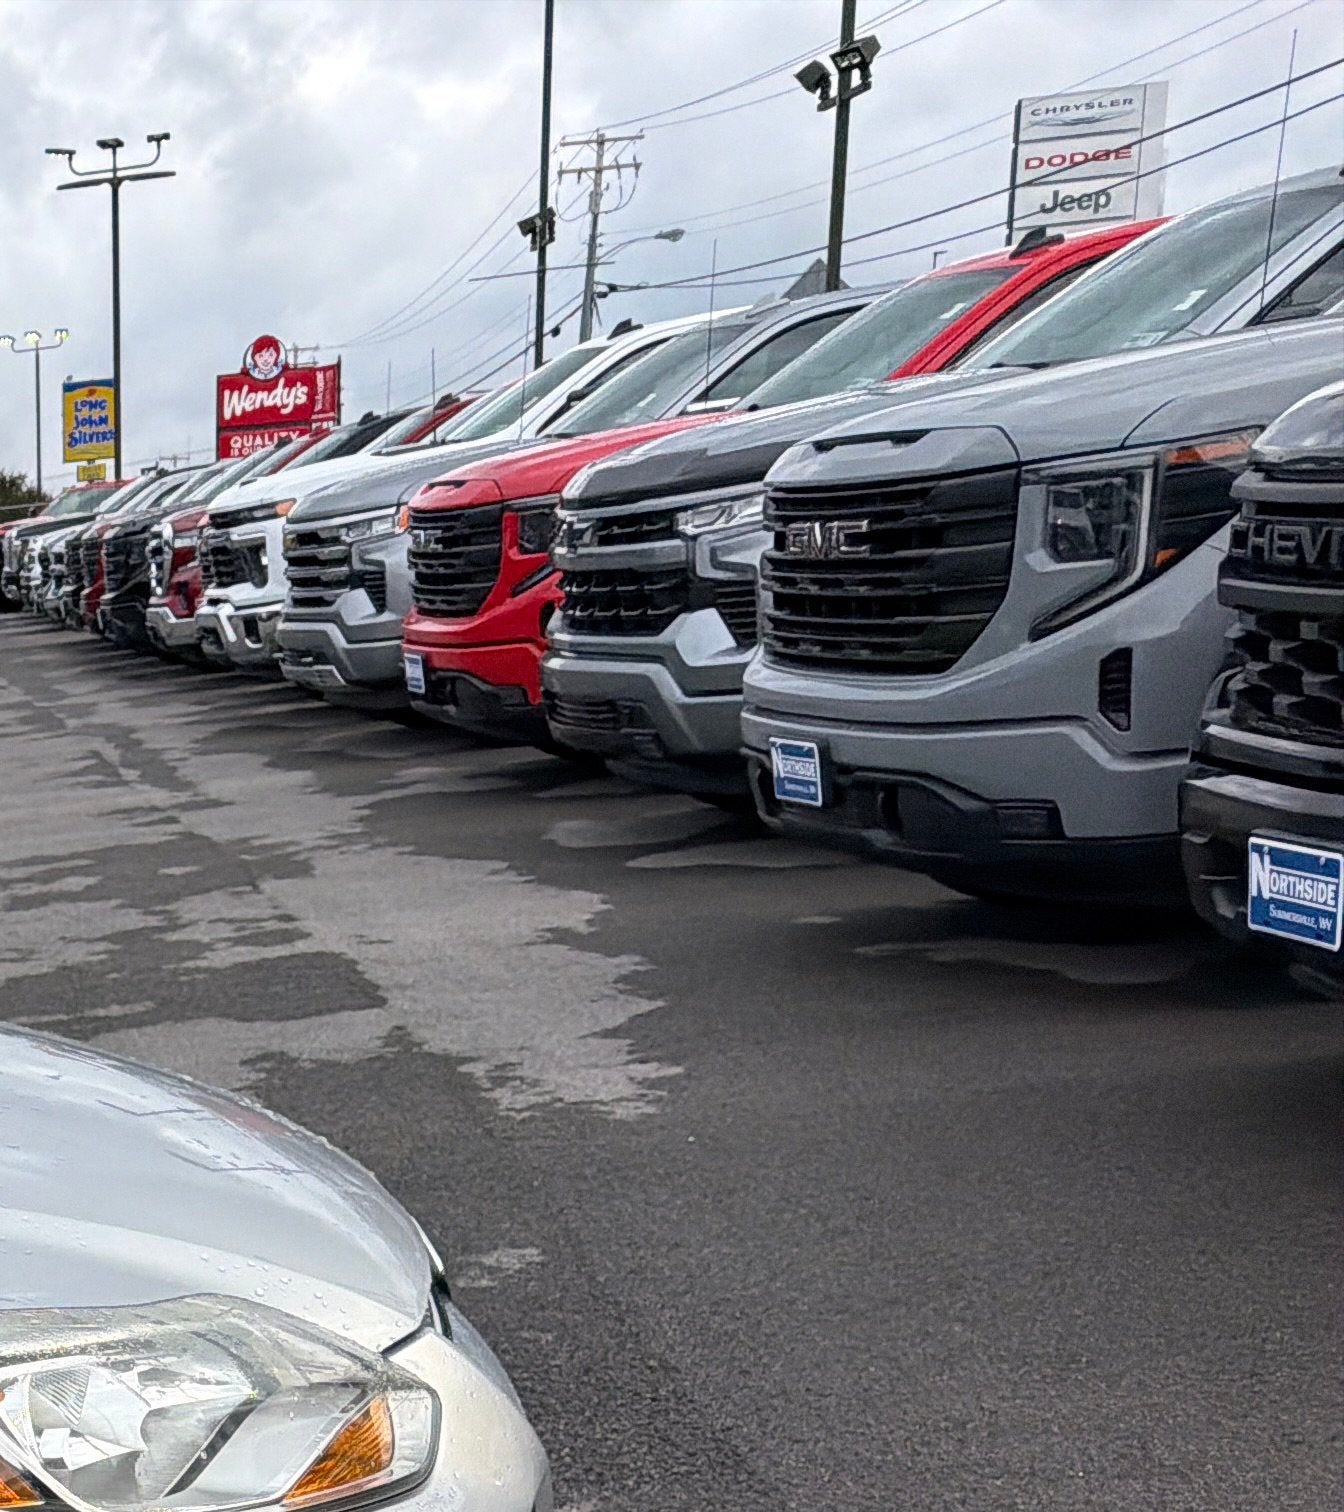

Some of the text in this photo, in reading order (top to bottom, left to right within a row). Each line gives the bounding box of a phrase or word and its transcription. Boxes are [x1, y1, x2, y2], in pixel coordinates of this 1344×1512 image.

[1031, 98, 1134, 116] CHRYSLER
[1025, 146, 1132, 170] DODGE
[1040, 190, 1112, 214] Jeep
[74, 399, 107, 413] LONG
[223, 377, 309, 420] Wendy's
[786, 521, 871, 558] GMC
[1252, 851, 1337, 906] NORTHSIDE
